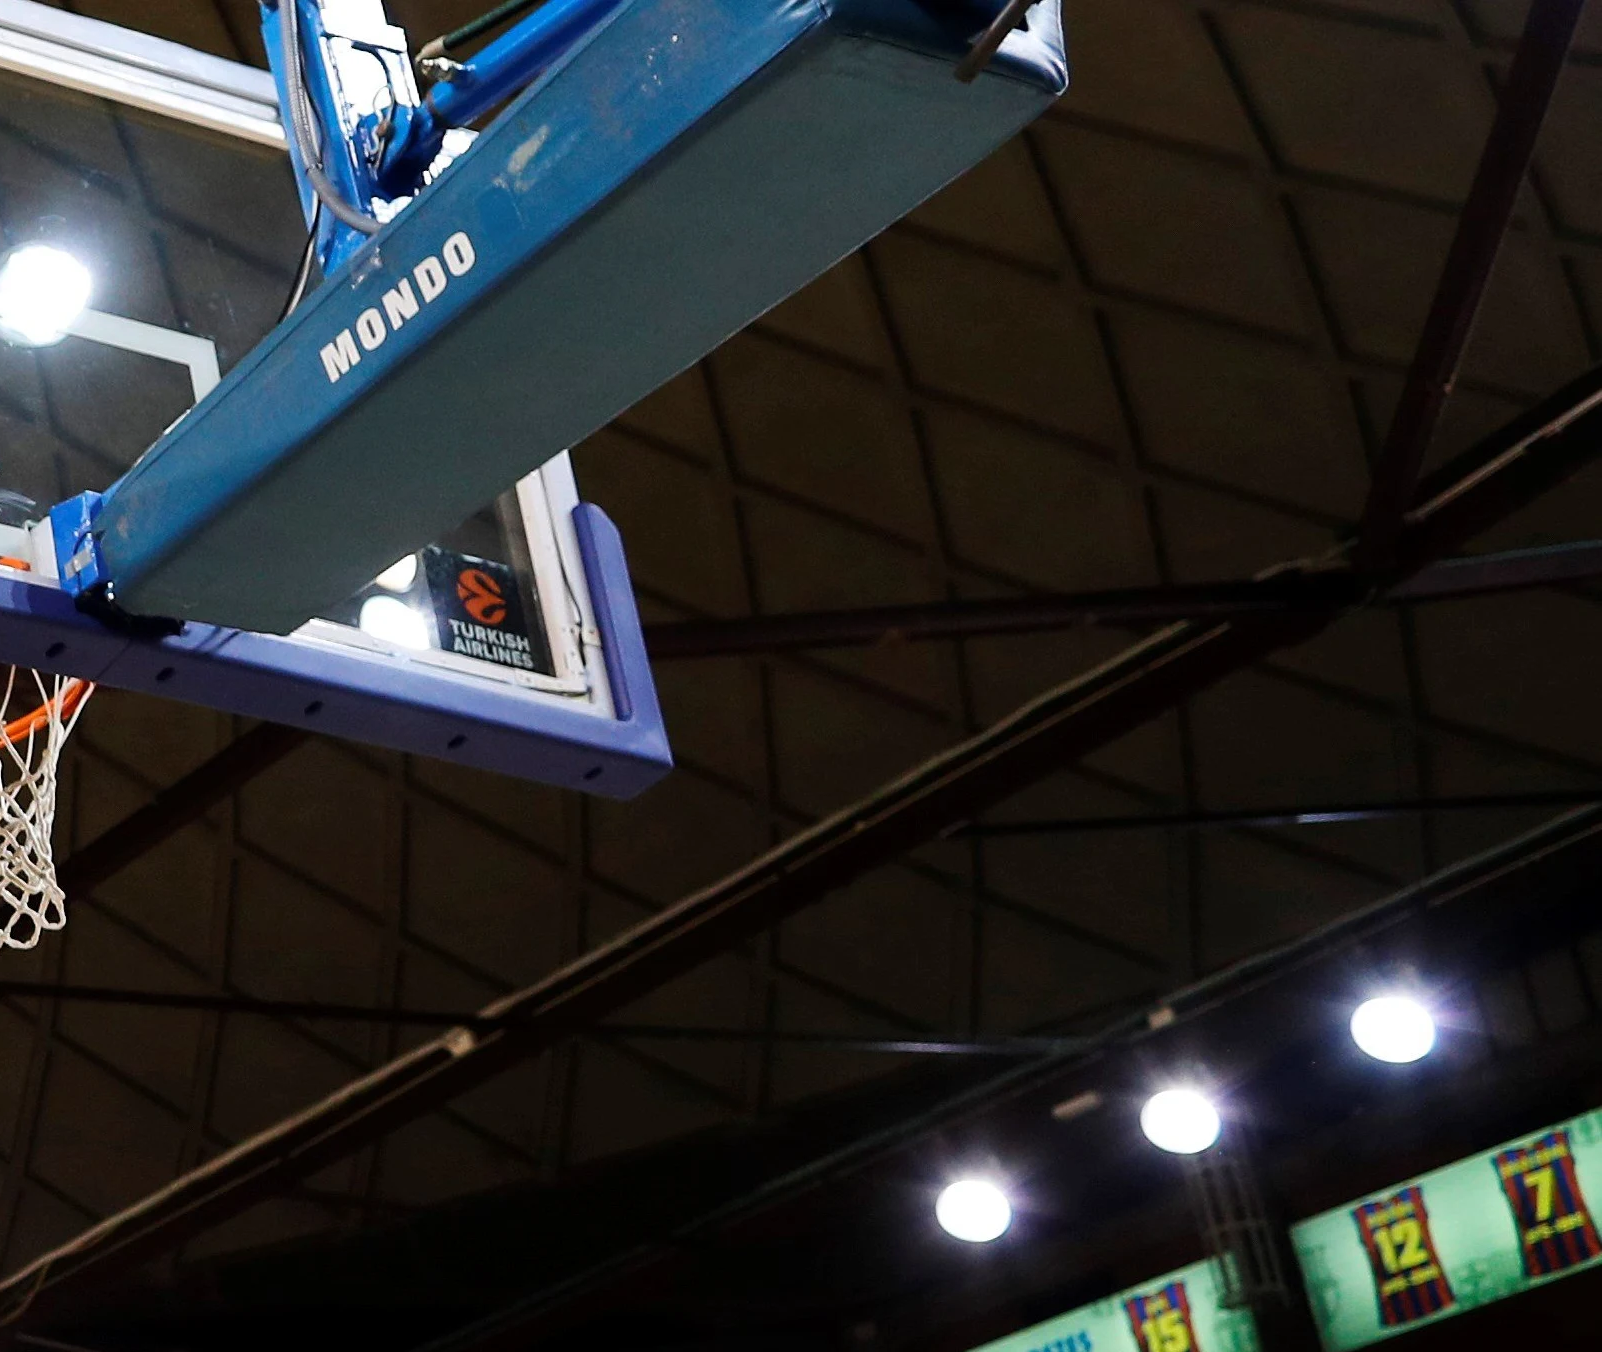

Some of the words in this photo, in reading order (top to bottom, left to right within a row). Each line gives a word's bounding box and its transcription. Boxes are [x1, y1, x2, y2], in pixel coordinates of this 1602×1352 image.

[319, 230, 476, 384] MONDO
[448, 619, 530, 651] TURKISH
[453, 636, 534, 668] AIRLINES
[1523, 1166, 1555, 1221] 7
[1374, 1218, 1428, 1275] 12
